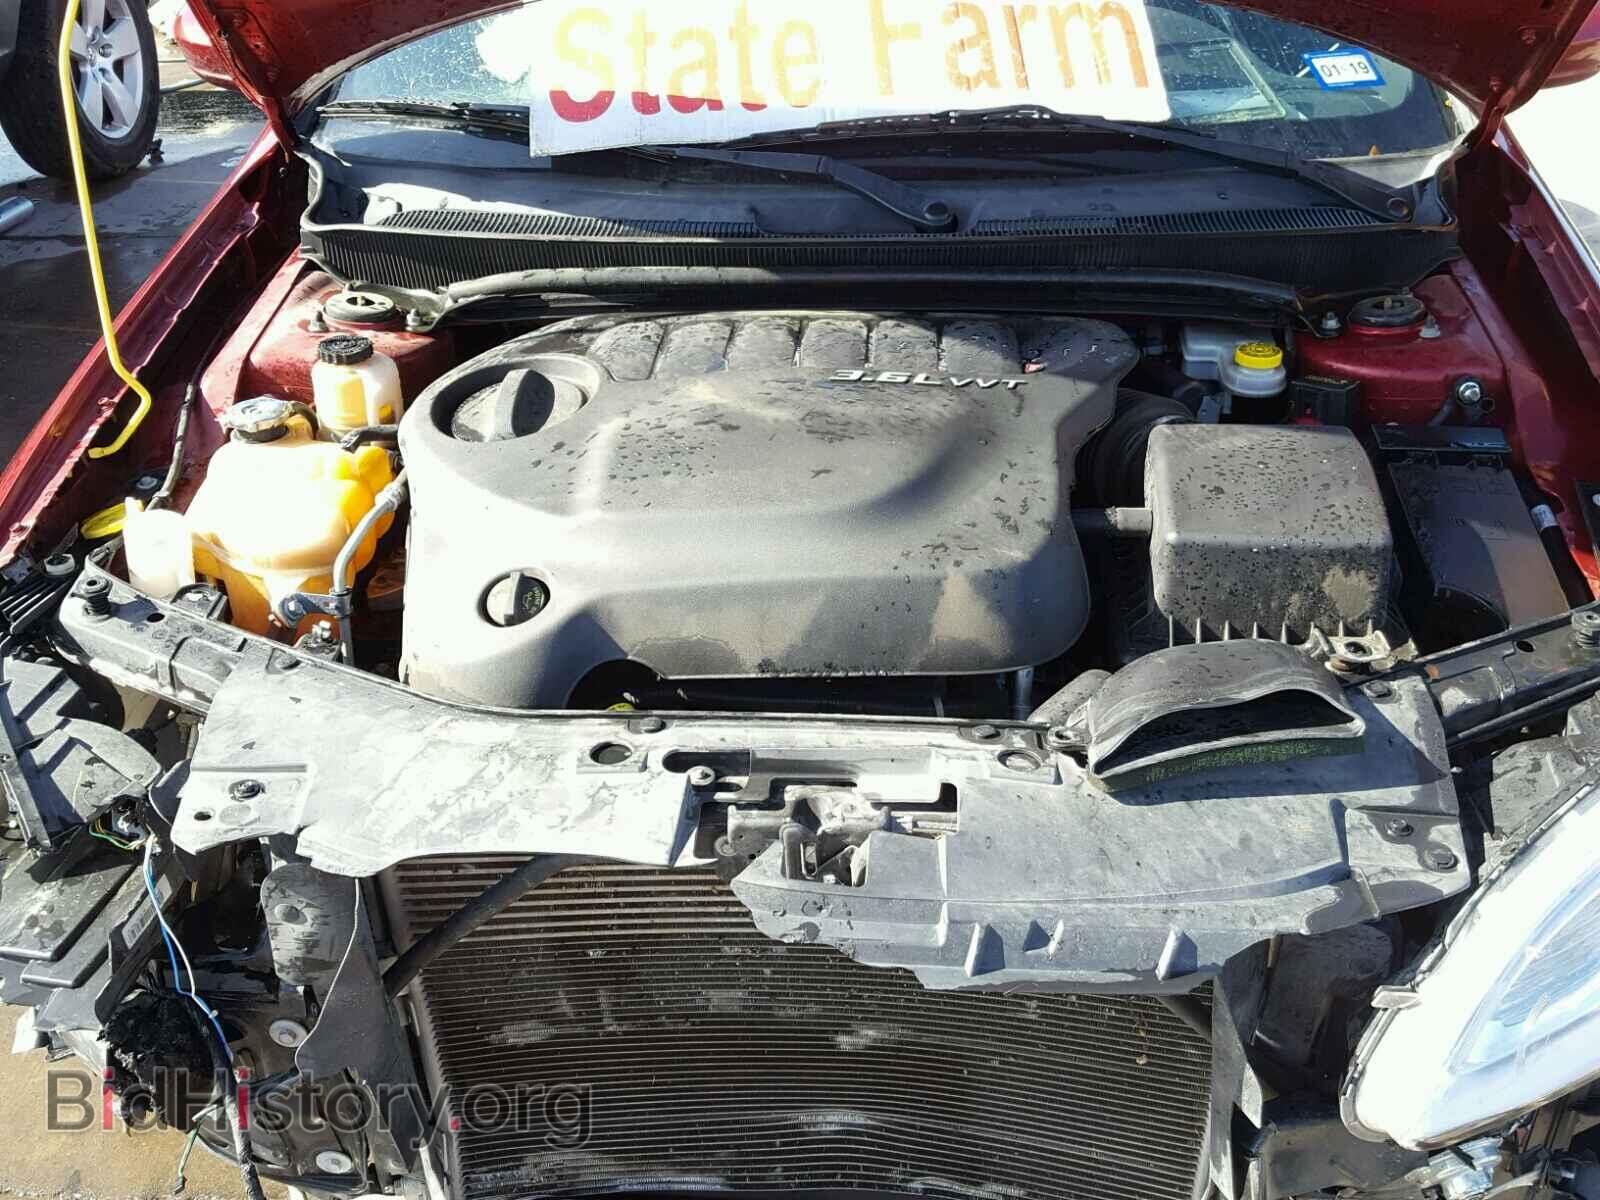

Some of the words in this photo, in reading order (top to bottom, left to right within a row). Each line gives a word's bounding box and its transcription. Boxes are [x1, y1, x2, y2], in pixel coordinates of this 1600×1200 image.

[548, 0, 820, 123] State
[868, 0, 1149, 95] Farm
[828, 369, 942, 386] 3.6L
[950, 377, 1029, 390] VVT
